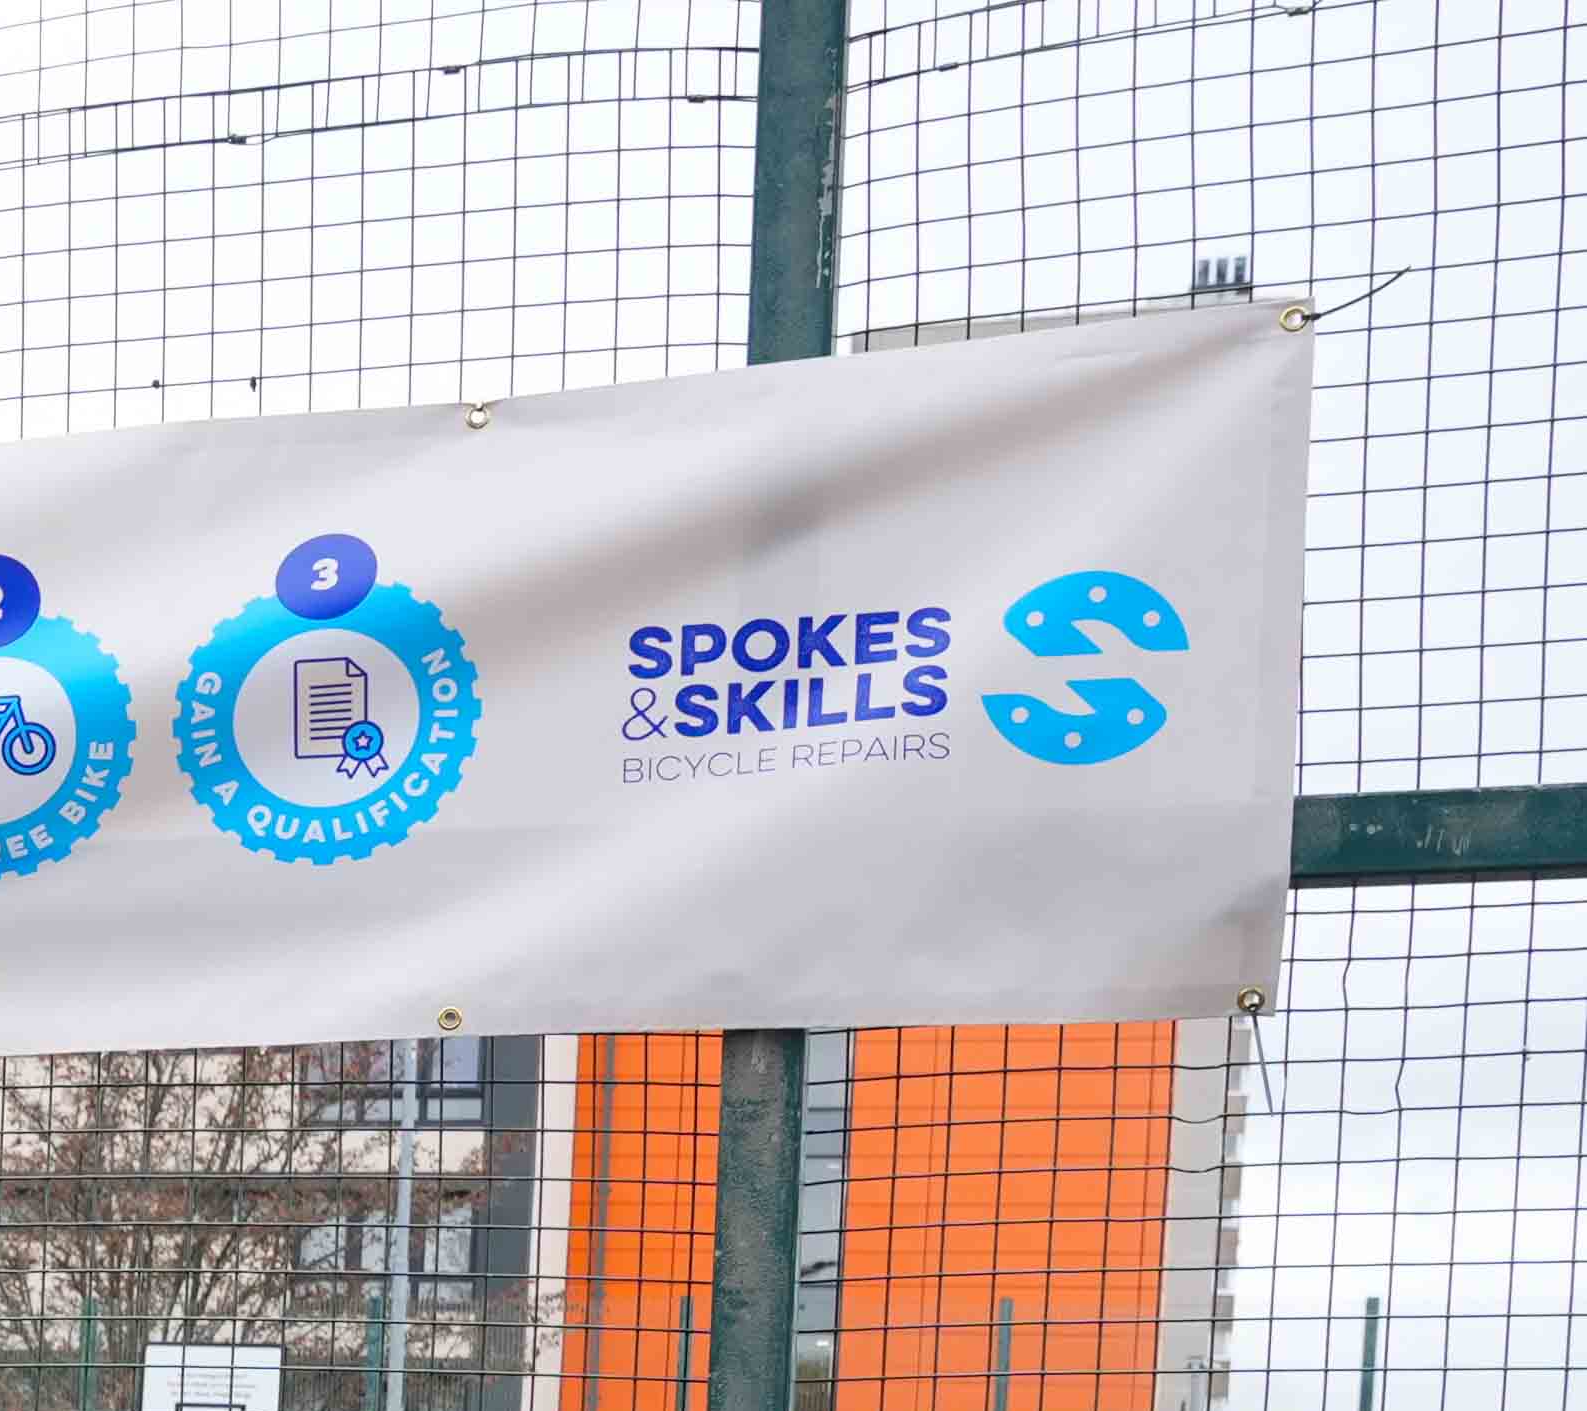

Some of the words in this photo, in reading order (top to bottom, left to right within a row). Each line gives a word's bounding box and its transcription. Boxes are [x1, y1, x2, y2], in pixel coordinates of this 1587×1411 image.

[310, 557, 340, 591] 3
[627, 605, 952, 681] SPOKES
[58, 740, 115, 825] BIKE
[190, 670, 224, 769] GAIN
[212, 778, 240, 806] A
[246, 647, 459, 844] QUALIFICATION
[622, 745, 777, 785] BICYCLE
[791, 731, 951, 770] REPAIRS
